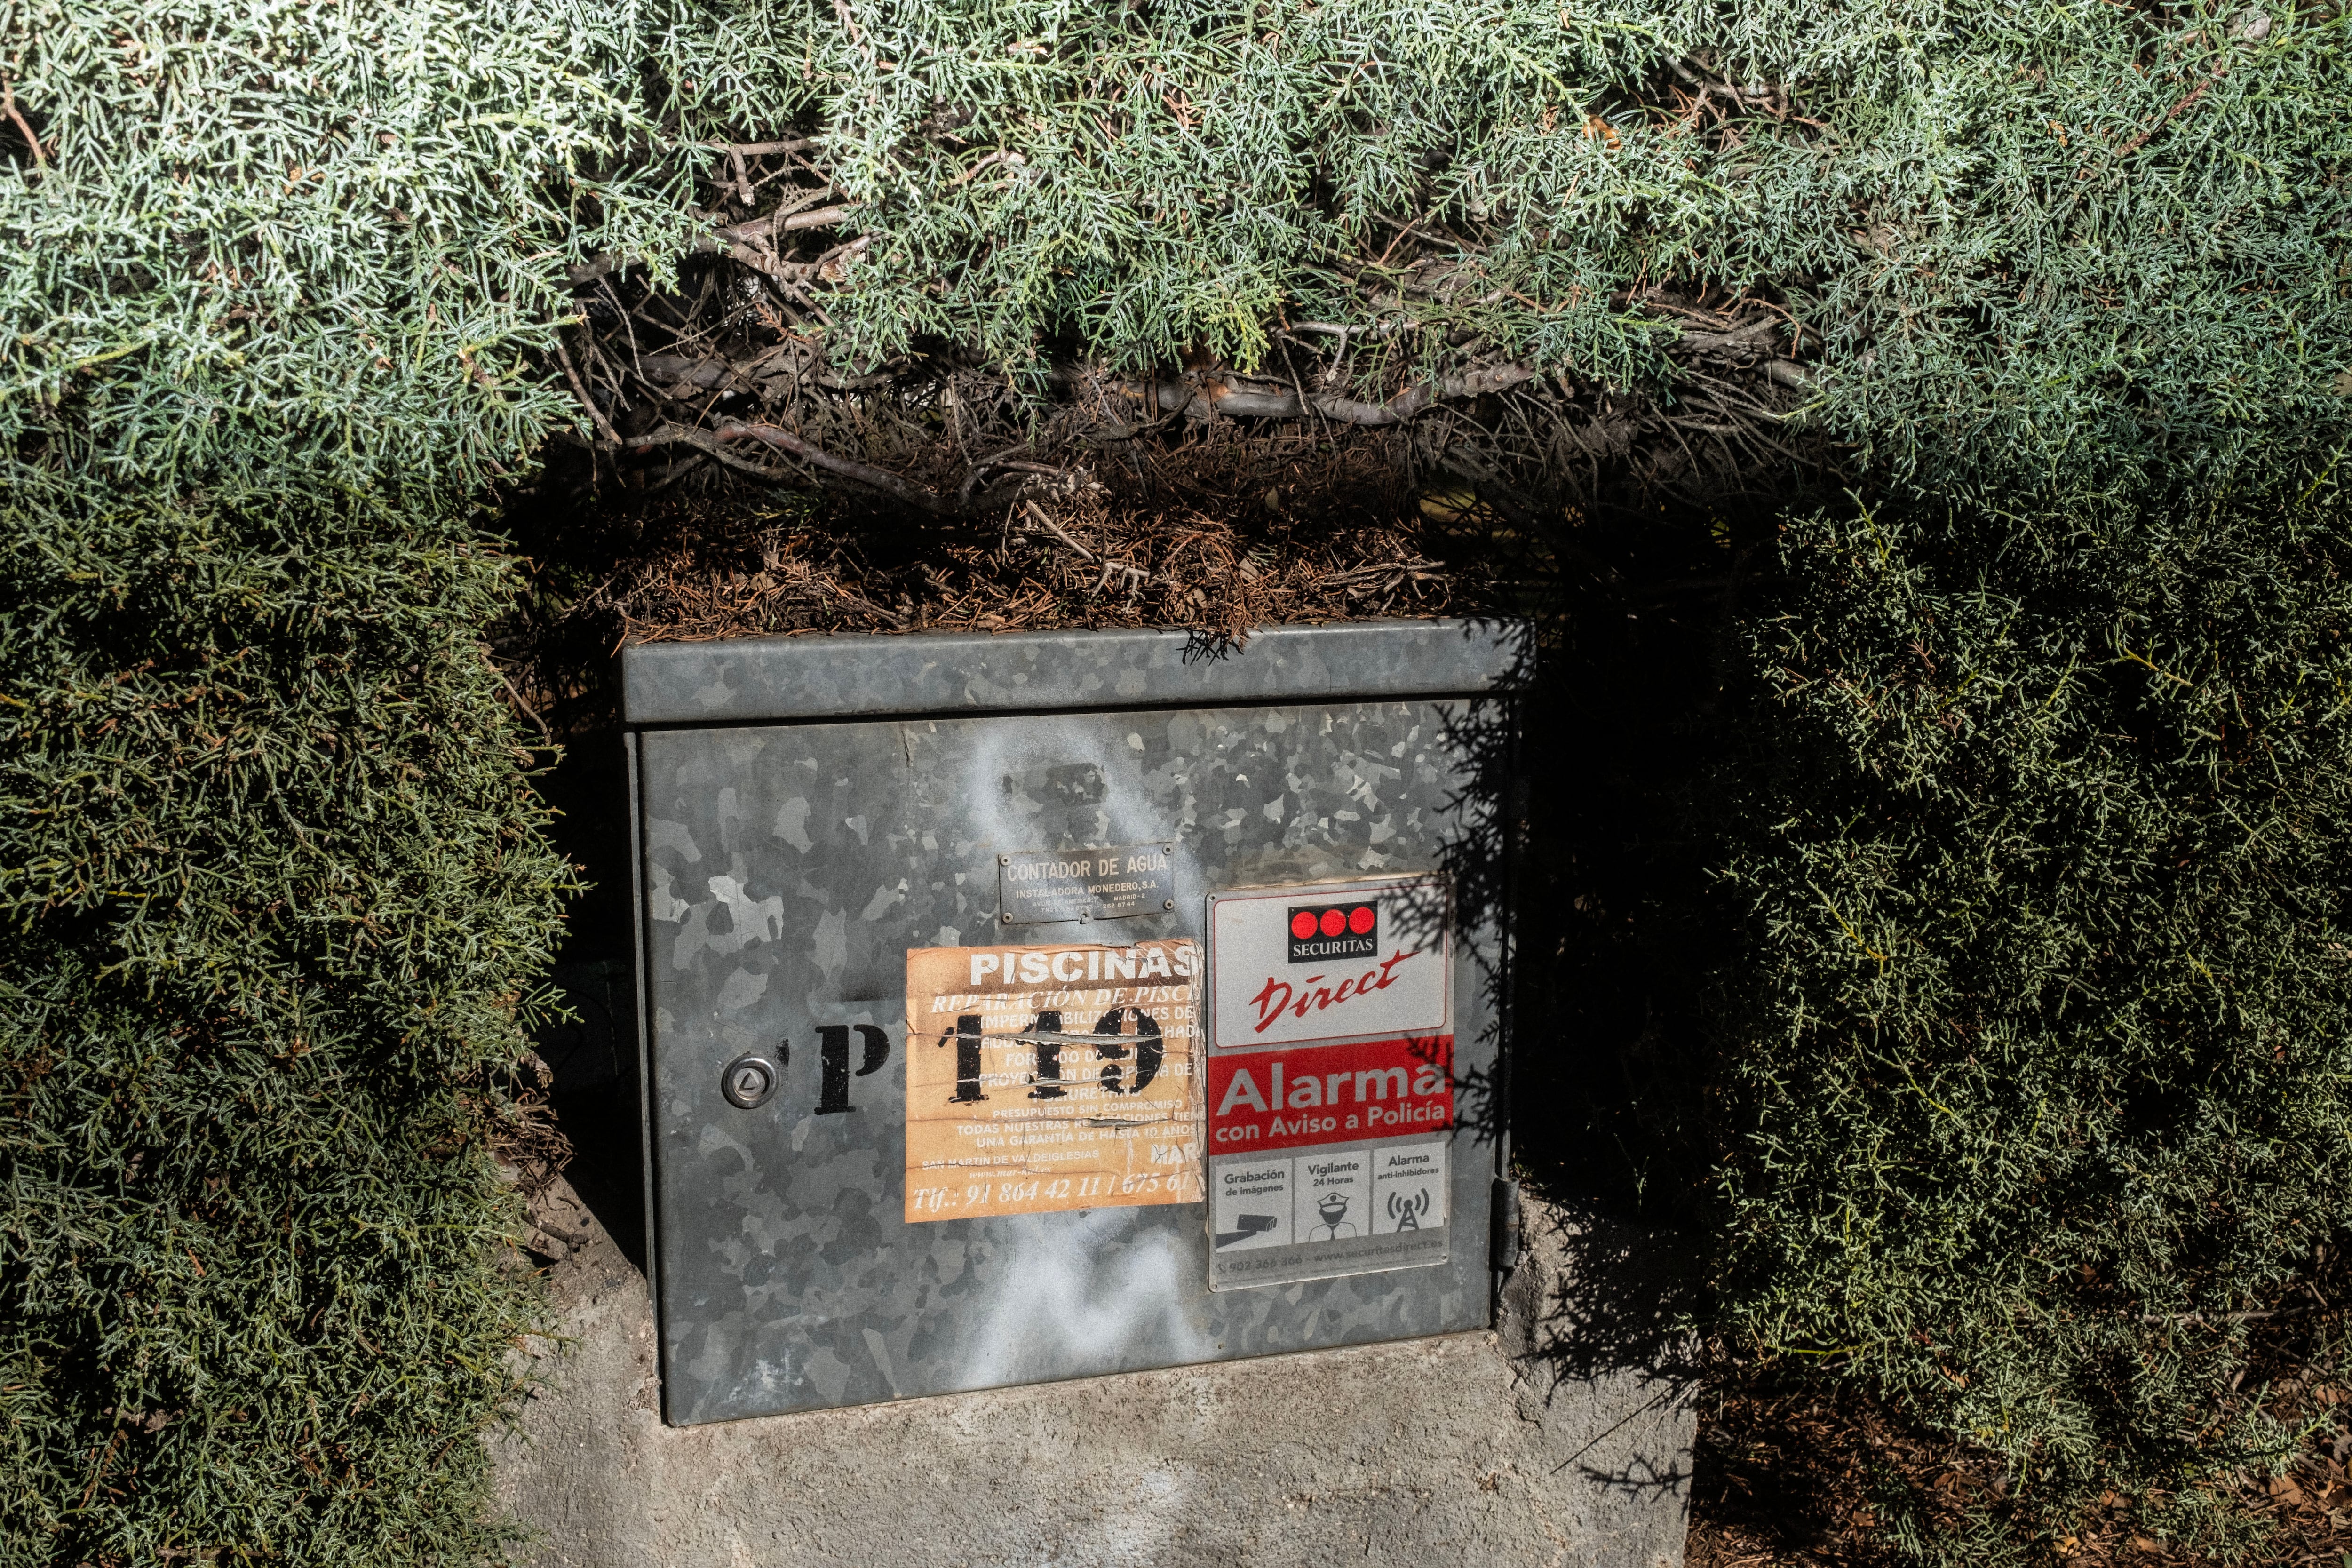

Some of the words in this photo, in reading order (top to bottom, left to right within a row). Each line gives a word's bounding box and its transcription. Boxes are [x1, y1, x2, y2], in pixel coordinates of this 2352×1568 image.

[1007, 860, 1090, 881] CONTADOR
[1099, 858, 1119, 876] DE
[1127, 854, 1167, 874] AGUA
[1016, 887, 1084, 899] INSTALADORA
[1293, 939, 1373, 957] SECURITAS
[970, 946, 1200, 985] PISCINAS
[930, 986, 1088, 1013] REPARACIÓN
[1091, 987, 1128, 1005] DE
[1249, 949, 1422, 1033] Direct
[1175, 1005, 1193, 1019] DE
[814, 1024, 890, 1115] P
[938, 1007, 1162, 1103] 119
[1006, 1051, 1079, 1067] FORDO
[1174, 1063, 1193, 1076] DE
[1216, 1062, 1446, 1116] Alarma
[993, 1106, 1074, 1118] PRESUPUESTO
[1079, 1105, 1098, 1114] SIN
[1103, 1099, 1183, 1112] COMPROMISO
[957, 1124, 1000, 1136] TODAS
[1004, 1121, 1069, 1133] NUESTRAS
[1216, 1124, 1259, 1142] con
[1268, 1114, 1336, 1137] Aviso
[1345, 1114, 1359, 1130] a
[1367, 1100, 1445, 1127] Policía
[977, 1137, 1005, 1148] UNA
[1009, 1130, 1074, 1146] GARANTÍA
[1079, 1131, 1095, 1141] DE
[1099, 1129, 1140, 1139] HASTA
[1144, 1127, 1158, 1137] 10
[1162, 1123, 1197, 1135] AÑOS
[922, 1159, 945, 1170] SAN
[948, 1156, 991, 1169] MARTIN
[993, 1155, 1009, 1165] DE
[1012, 1150, 1099, 1163] VALDEIGLESIAS
[1388, 1155, 1430, 1166] Alarma
[1224, 1169, 1285, 1184] Grabación
[1308, 1162, 1359, 1177] Vigilante
[1226, 1187, 1238, 1196] de
[1240, 1185, 1284, 1195] imágenes
[1313, 1178, 1325, 1187] 24
[1327, 1177, 1354, 1185] Horas
[914, 1186, 959, 1214] Tlf.:
[965, 1184, 991, 1206] 91
[999, 1180, 1039, 1202] 864
[1044, 1179, 1071, 1199] 42
[1077, 1176, 1101, 1197] 11
[1123, 1172, 1160, 1194] 675
[1230, 1261, 1251, 1272] 902
